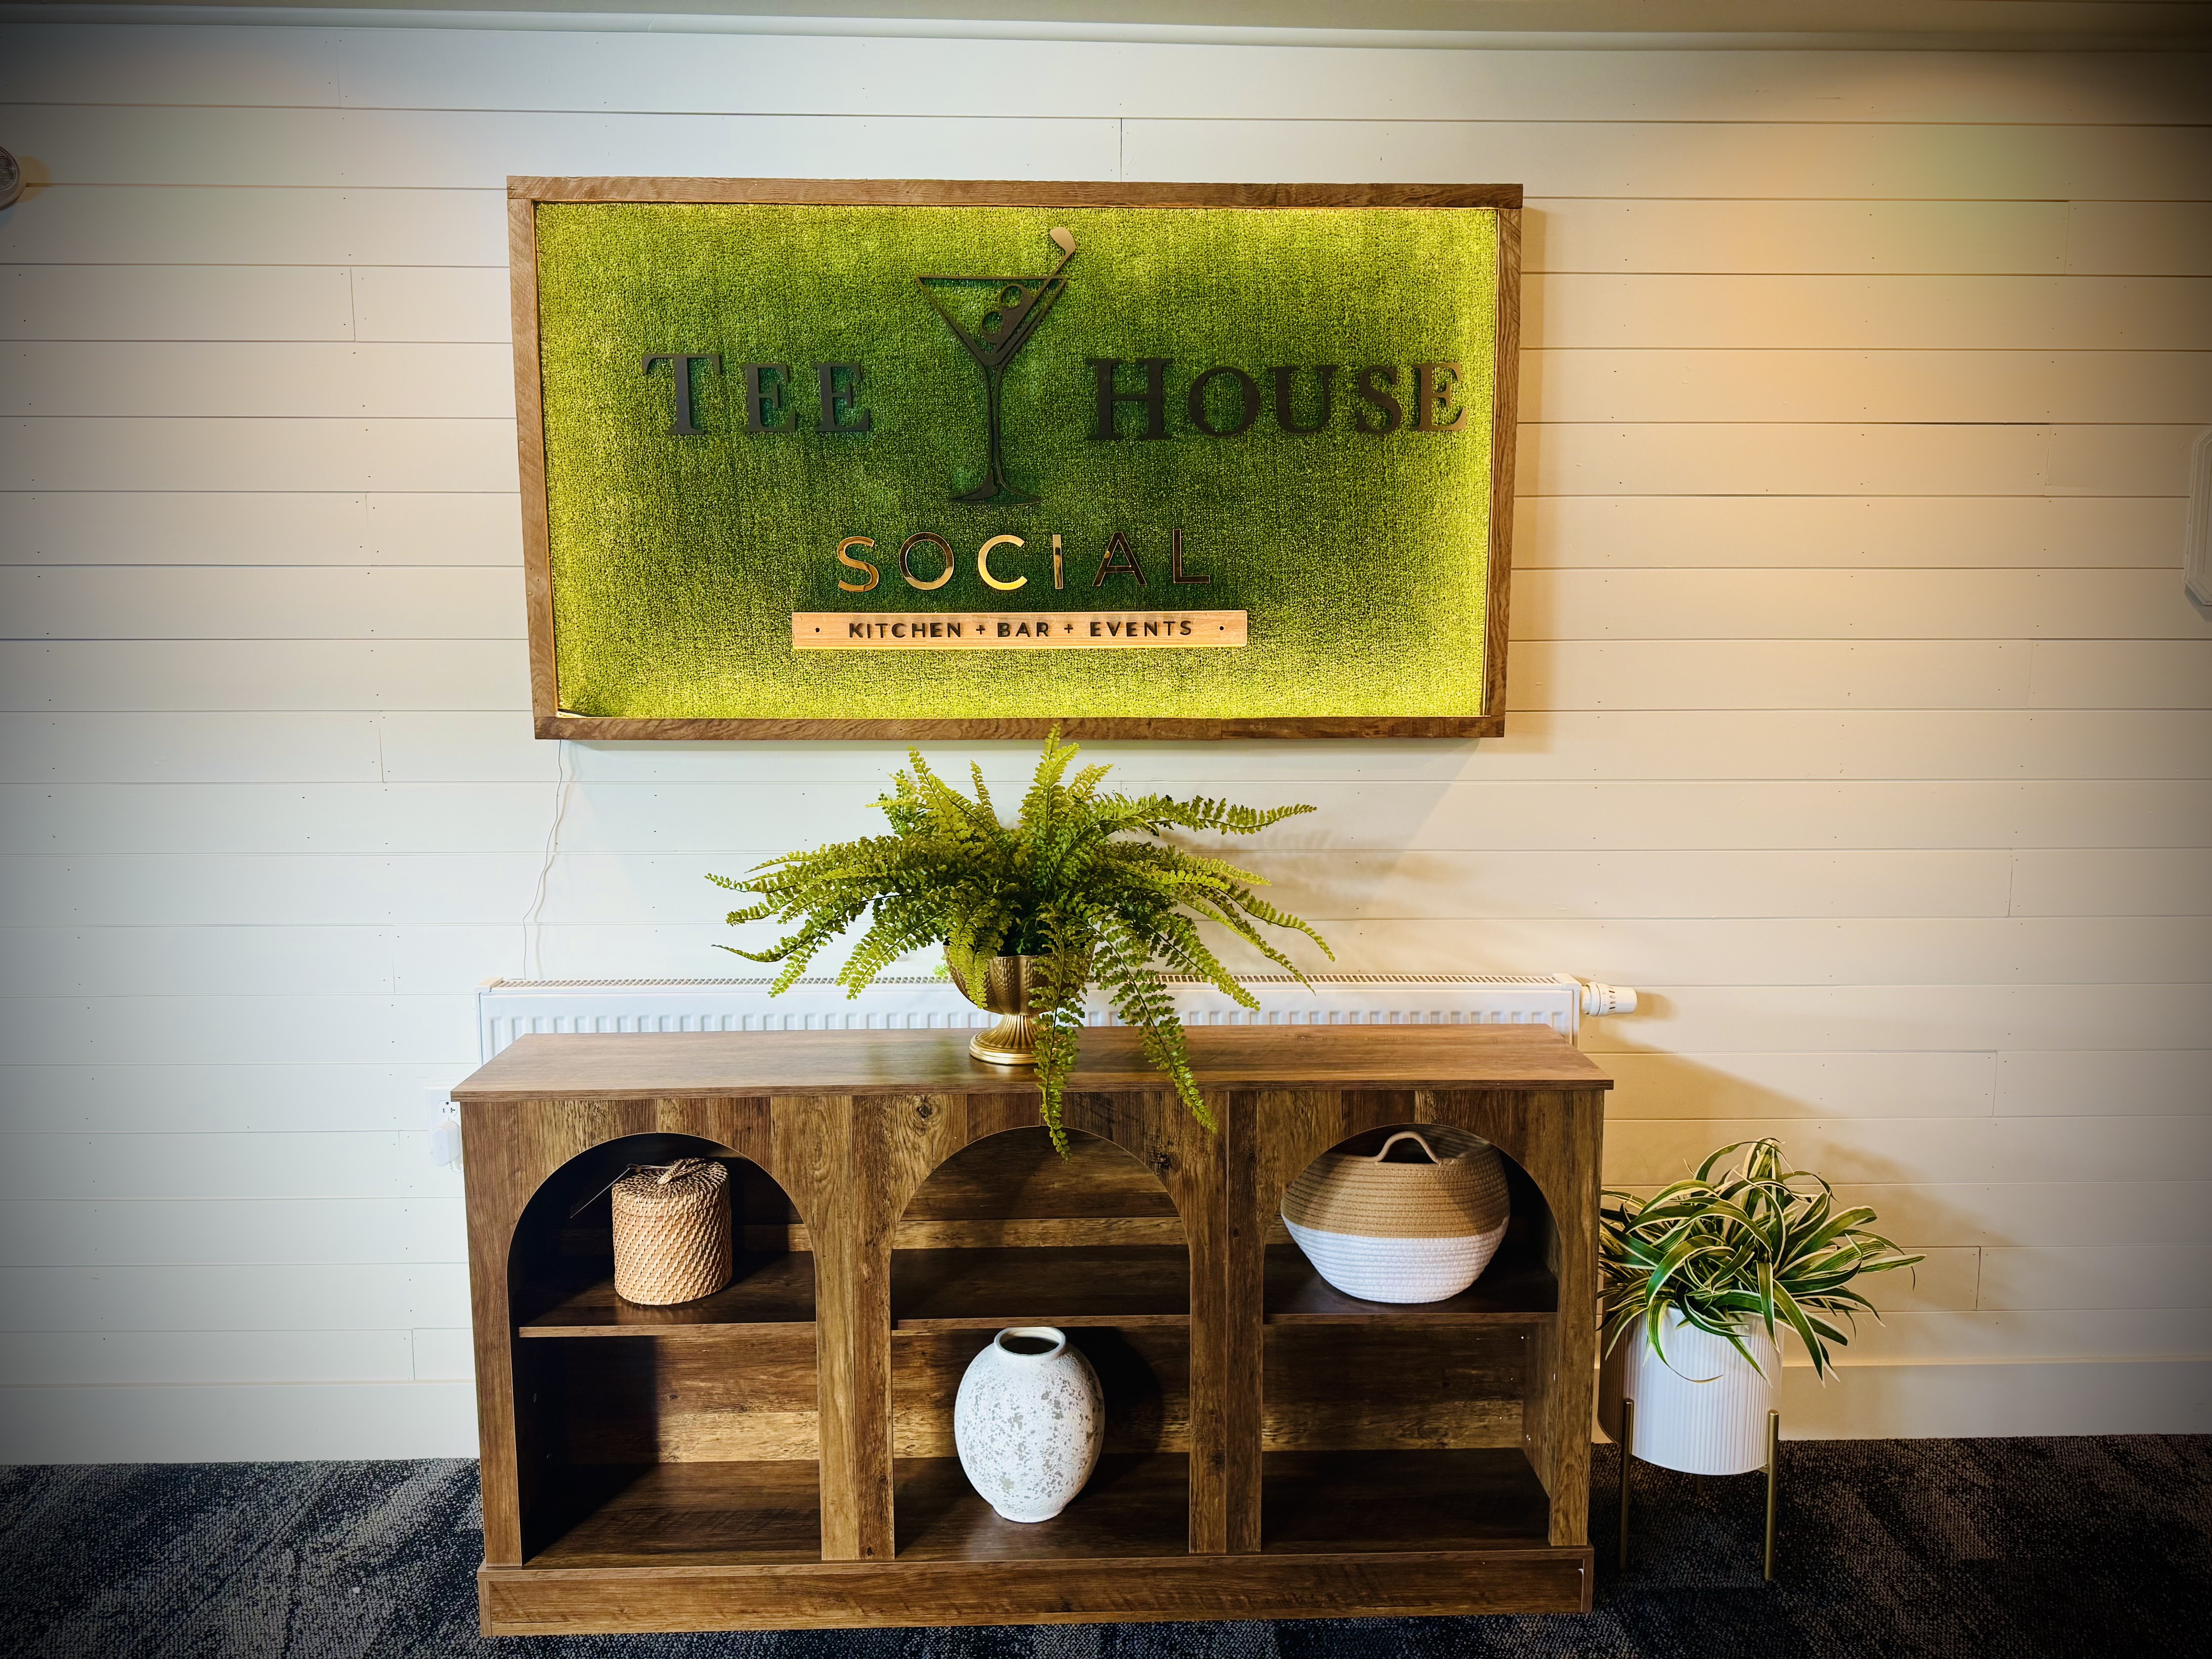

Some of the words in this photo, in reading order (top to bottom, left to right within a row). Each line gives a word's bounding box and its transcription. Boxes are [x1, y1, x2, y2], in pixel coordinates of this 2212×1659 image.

[641, 352, 871, 435] TEE
[1085, 357, 1467, 441] HOUSE
[837, 528, 1211, 592] SOCIAL
[849, 622, 961, 638] KITCHEN
[997, 622, 1049, 637] BAR
[1090, 620, 1192, 637] EVENTS
